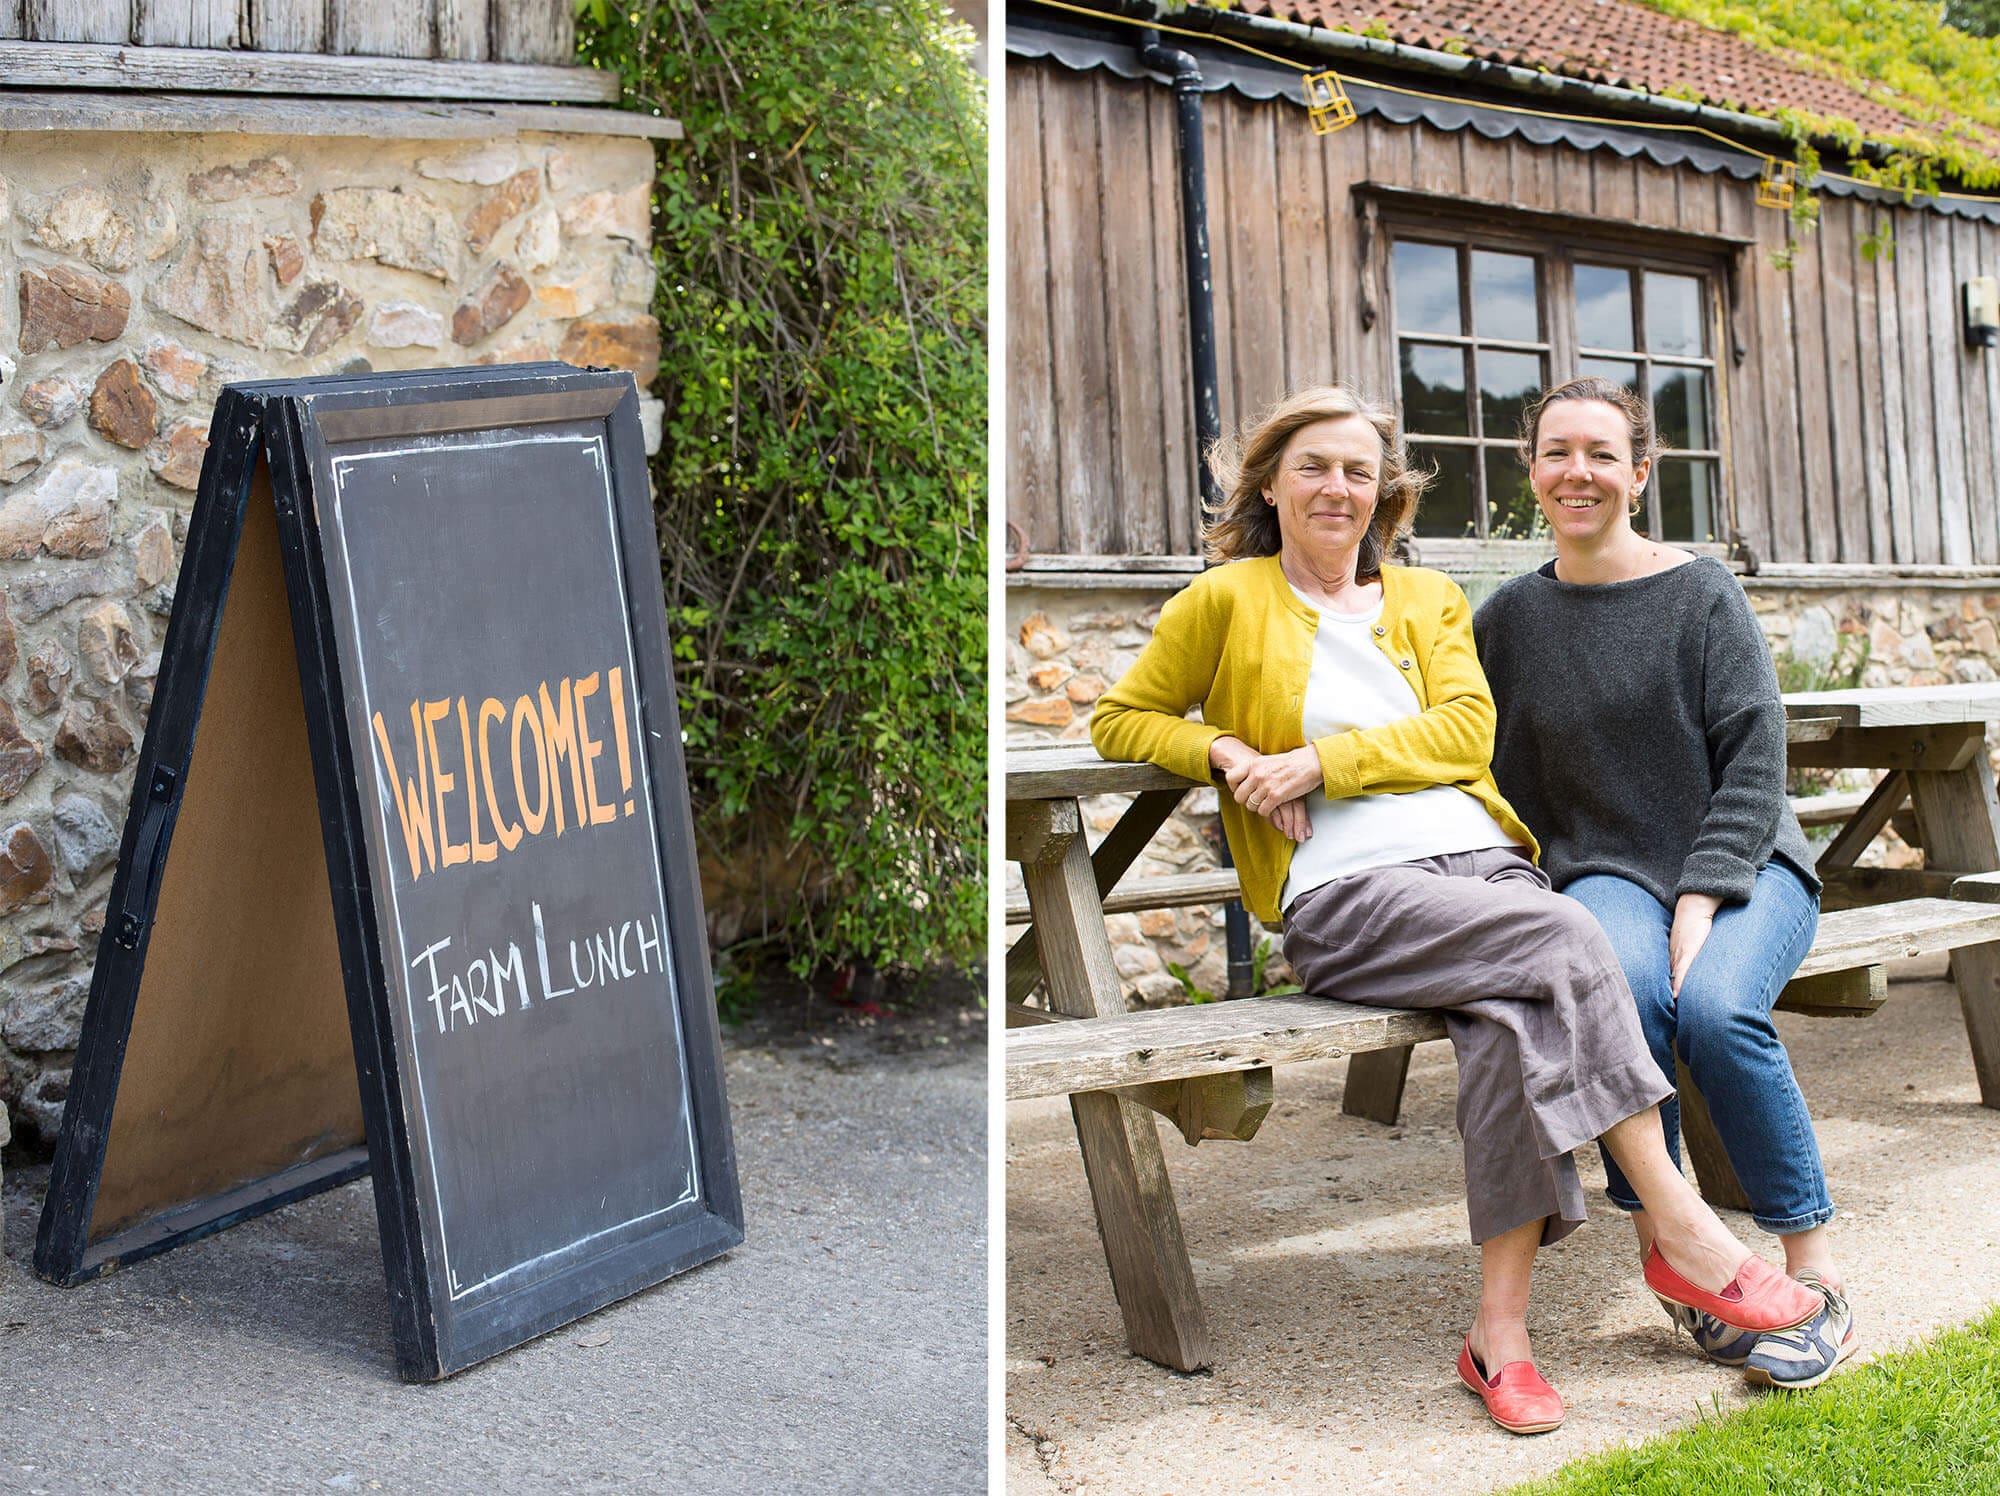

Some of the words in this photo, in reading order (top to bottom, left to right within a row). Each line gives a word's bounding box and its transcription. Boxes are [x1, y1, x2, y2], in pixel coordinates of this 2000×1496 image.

[372, 666, 635, 882] WELCOME!
[411, 936, 531, 1033] FARM
[532, 901, 664, 1000] LUNCH
